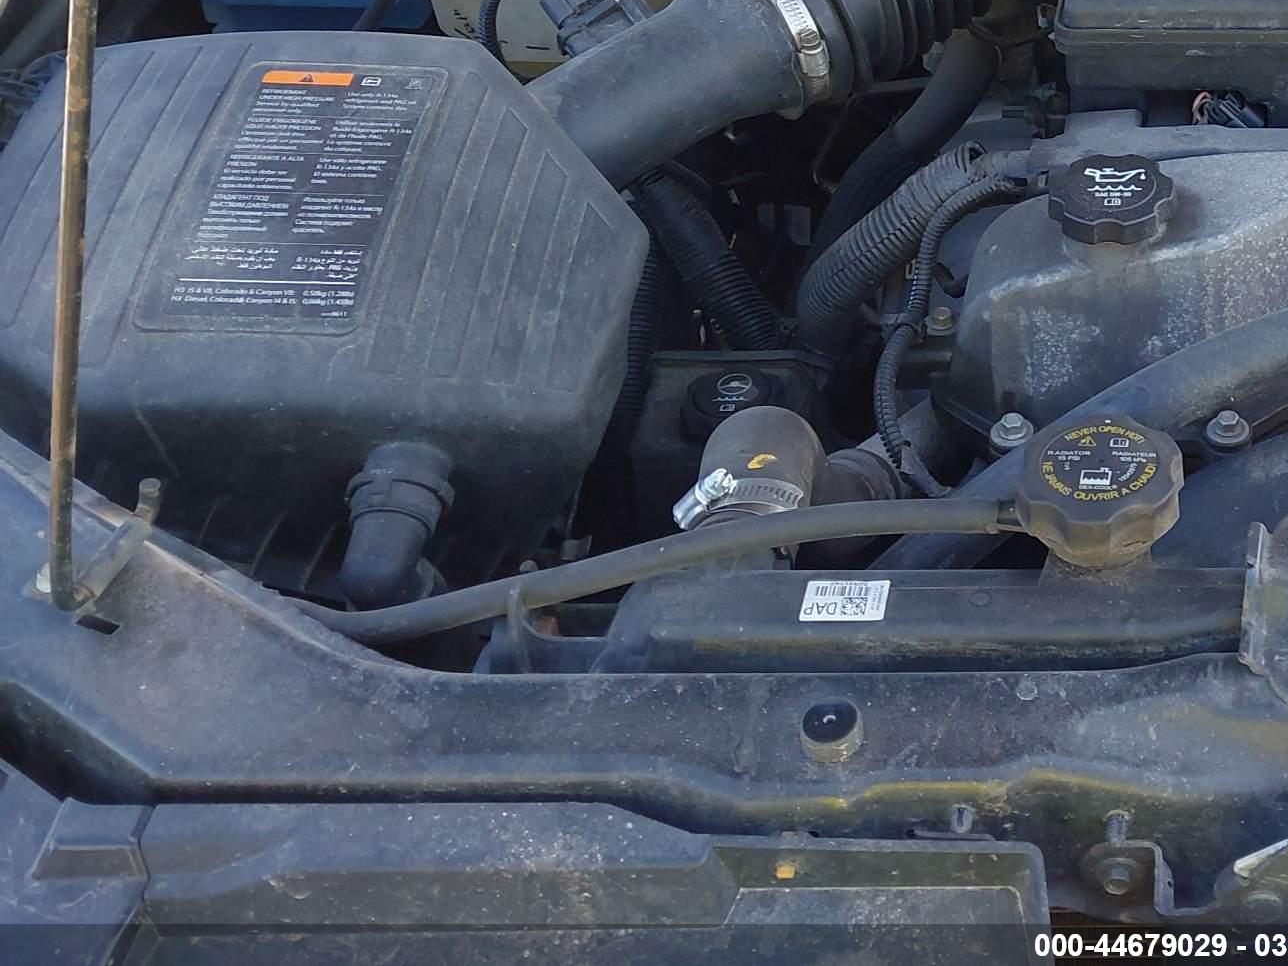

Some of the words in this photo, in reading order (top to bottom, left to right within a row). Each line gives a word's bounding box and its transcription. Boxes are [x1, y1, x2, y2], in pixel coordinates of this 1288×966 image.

[1064, 426, 1097, 441] NEVER
[1099, 425, 1125, 435] OPEN
[1044, 472, 1073, 496] JAMAIS
[1073, 490, 1120, 501] OUVRIR
[1121, 487, 1131, 496] A
[803, 601, 838, 616] DAP
